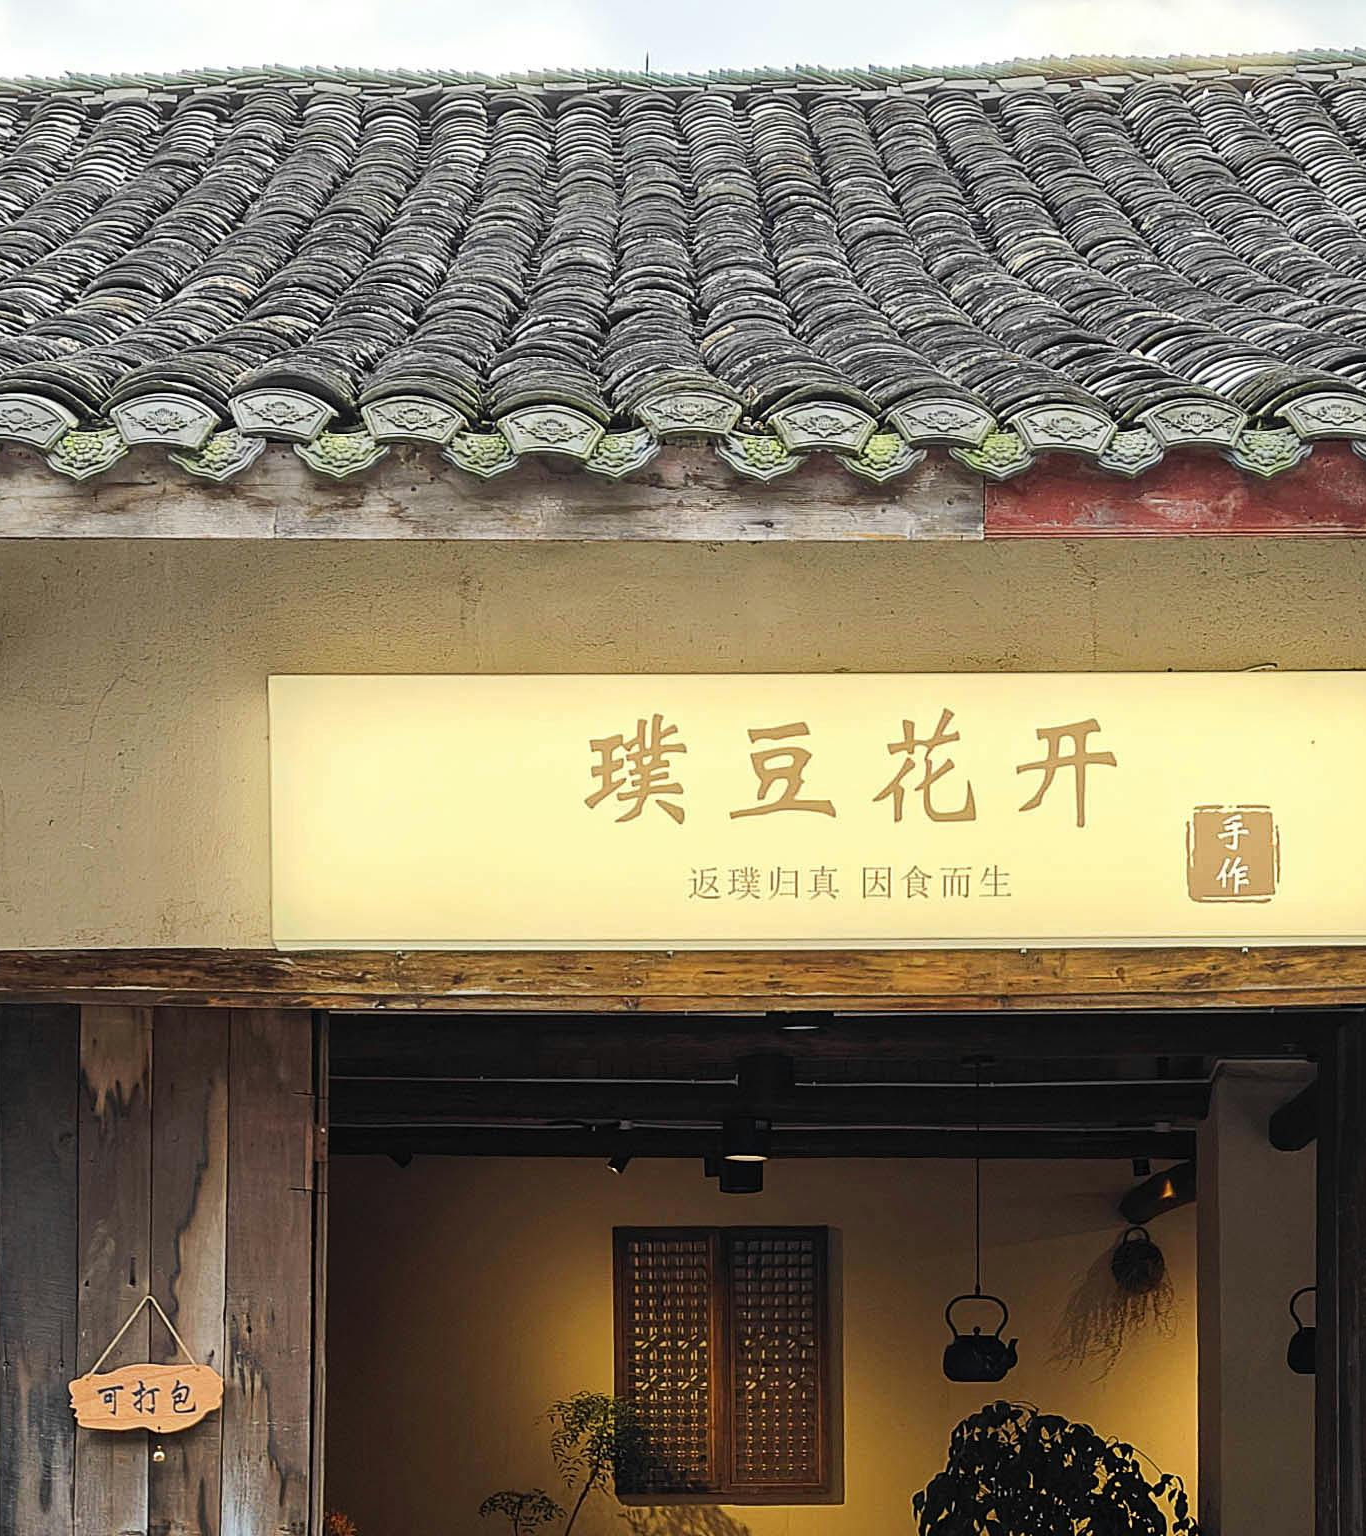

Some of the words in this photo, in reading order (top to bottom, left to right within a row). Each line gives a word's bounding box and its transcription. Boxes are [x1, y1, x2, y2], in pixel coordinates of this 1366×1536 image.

[584, 708, 1118, 829] 璞豆花开
[688, 865, 839, 900] 返璞归真
[862, 864, 1012, 900] 因食而生
[1215, 813, 1250, 895] 手作
[97, 1379, 199, 1416] 可打包
